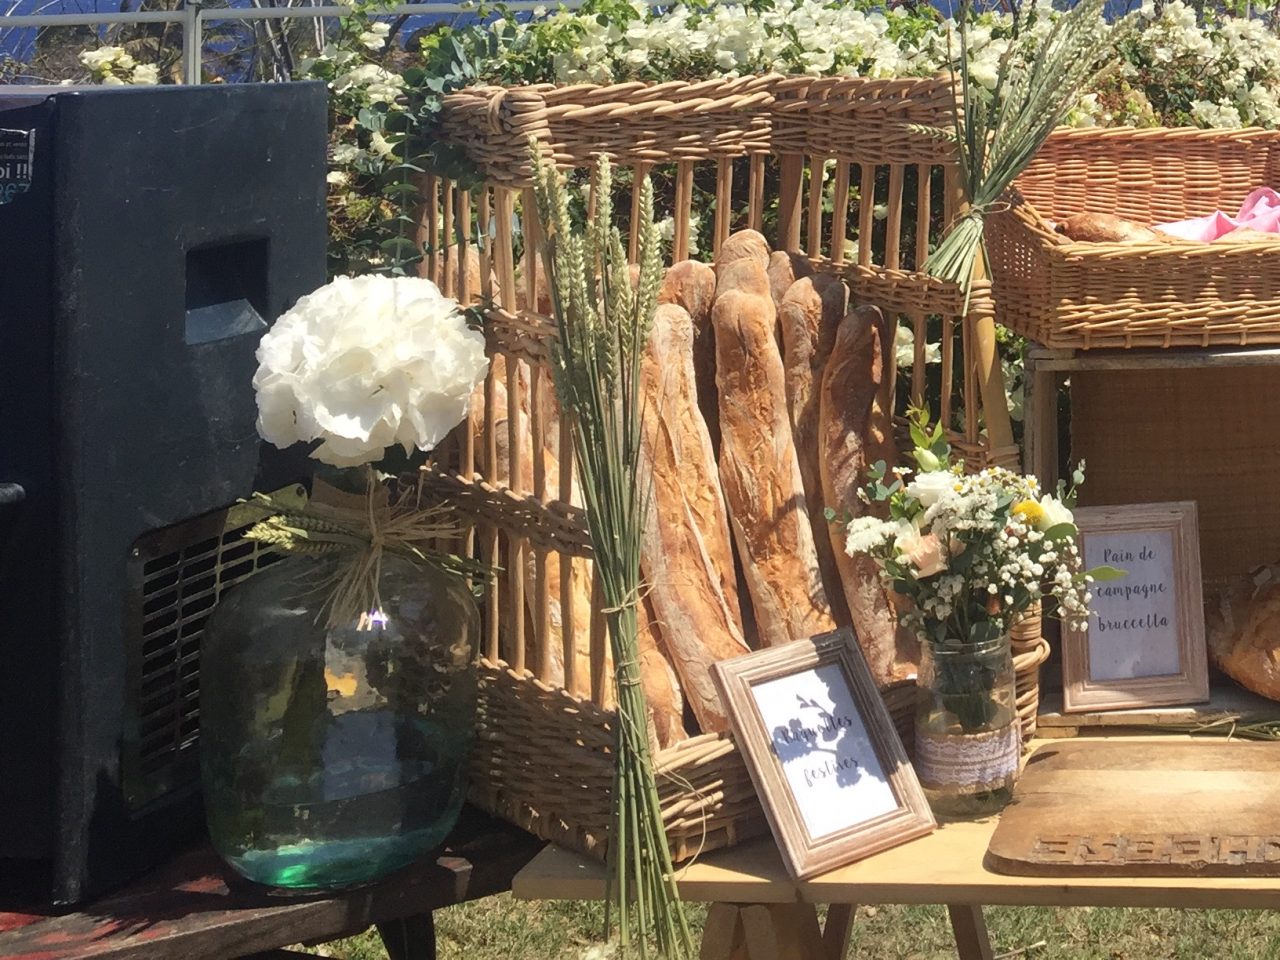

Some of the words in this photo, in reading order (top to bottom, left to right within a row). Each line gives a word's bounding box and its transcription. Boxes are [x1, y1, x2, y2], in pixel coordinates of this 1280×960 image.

[1104, 548, 1135, 563] Pain
[1139, 546, 1156, 561] de
[1097, 582, 1167, 600] campagne
[803, 756, 859, 788] festives
